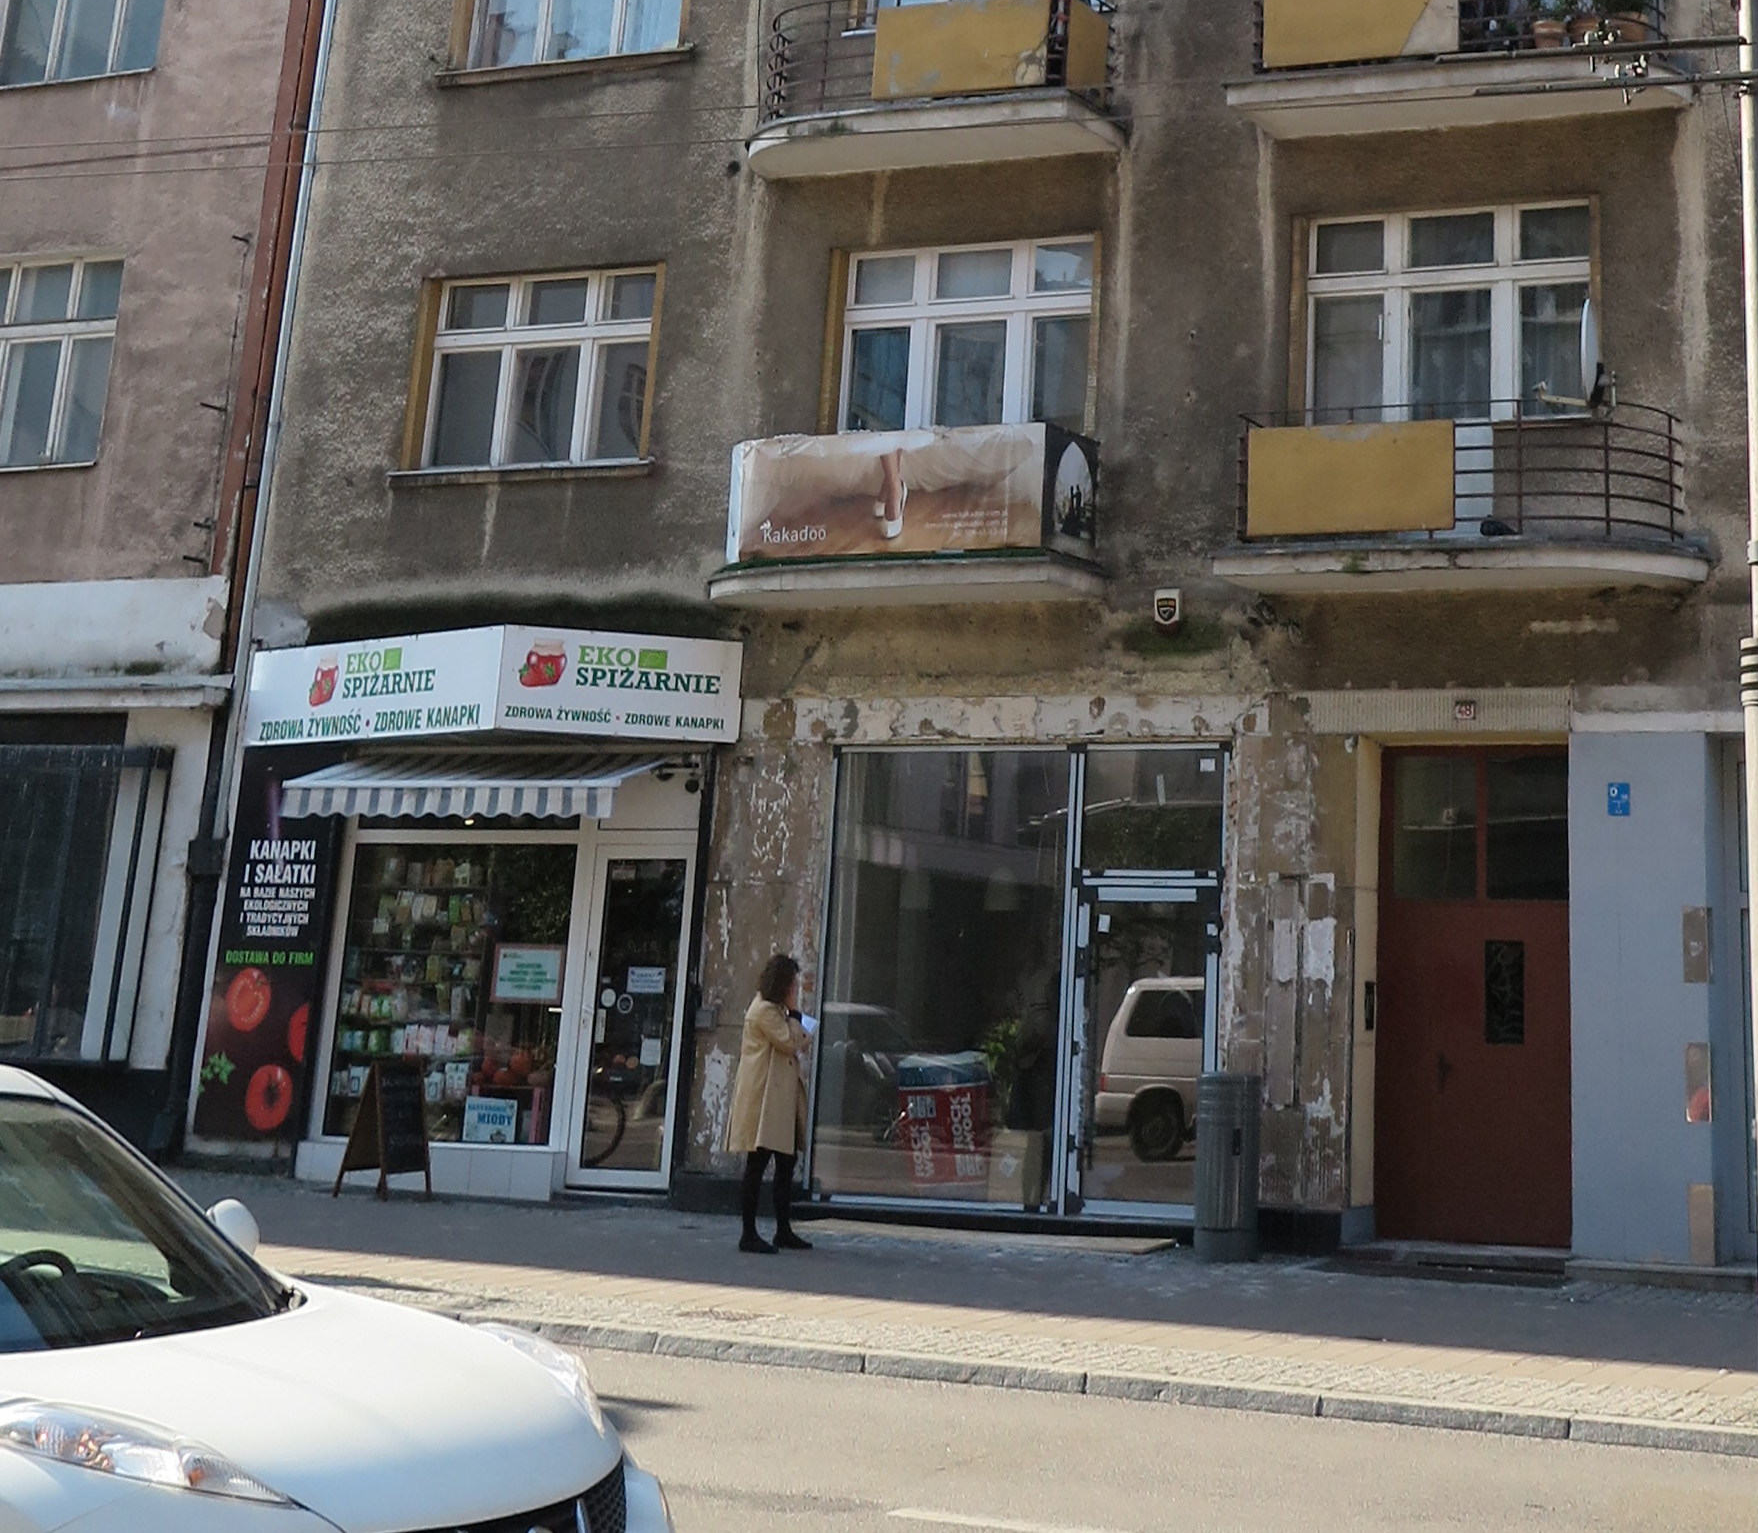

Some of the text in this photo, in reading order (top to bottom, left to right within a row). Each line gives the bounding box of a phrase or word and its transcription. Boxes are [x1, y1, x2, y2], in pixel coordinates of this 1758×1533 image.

[763, 526, 827, 544] Kakadoo
[345, 650, 382, 675] EKO
[578, 644, 637, 667] EKO
[342, 668, 436, 700] SPIŻARNIE
[575, 667, 721, 695] SPIŻARNIE
[259, 703, 481, 742] ZDROWA ŻYWNOŚĆ ZDROWE KANAPKI
[504, 705, 725, 730] ZDROWA ŻYWNOŚĆ ZDROWE KANAPKI
[1457, 704, 1473, 716] 48
[249, 839, 317, 860] KANAPKI
[243, 863, 317, 884] I SAŁATKI
[225, 950, 314, 966] DOSTAWA DO FIRM
[950, 1095, 965, 1149] ROCK
[910, 1124, 925, 1177] ROCK
